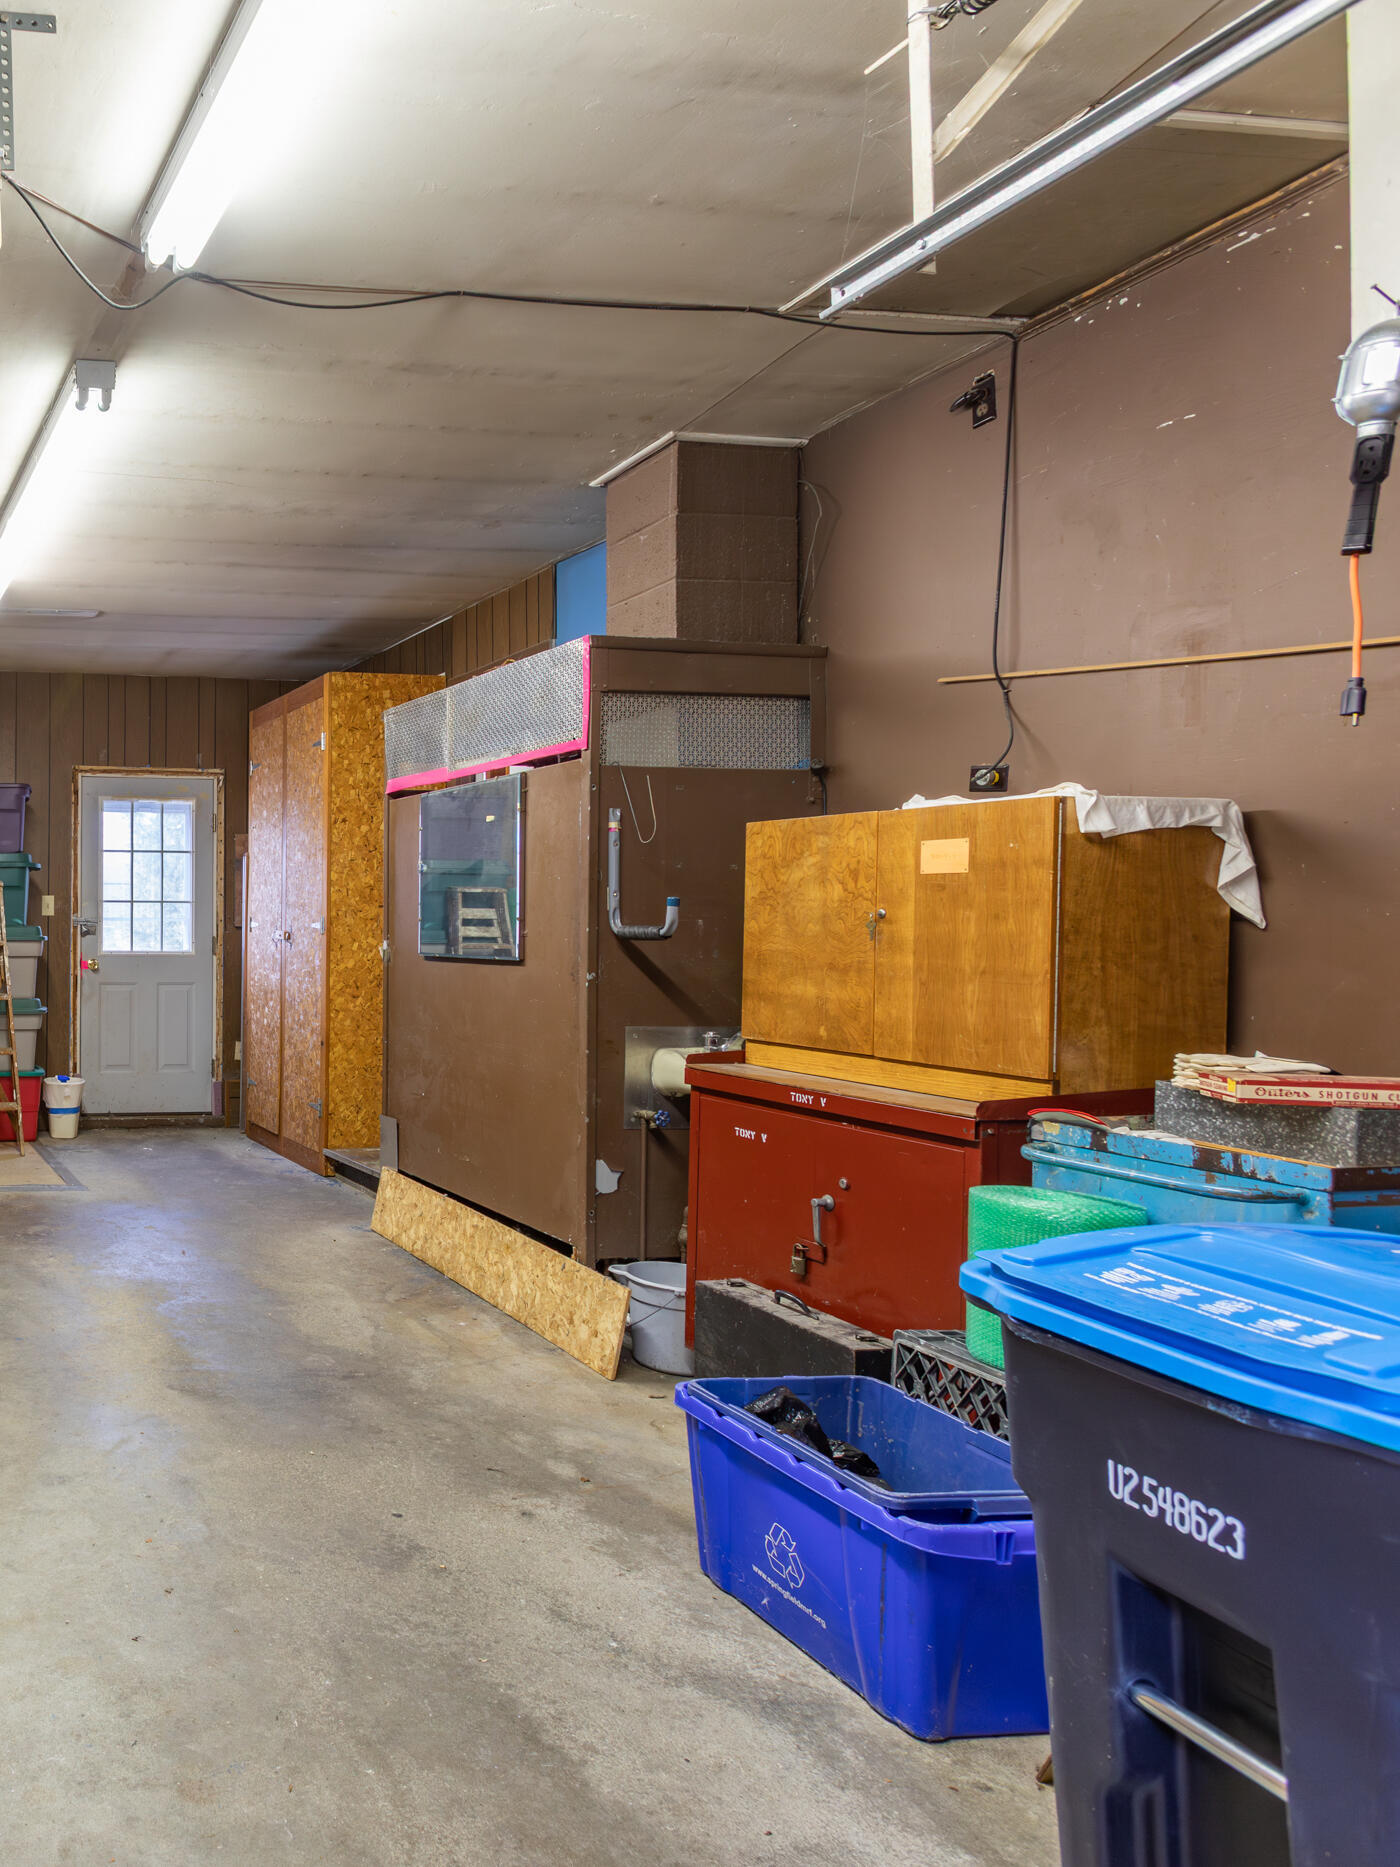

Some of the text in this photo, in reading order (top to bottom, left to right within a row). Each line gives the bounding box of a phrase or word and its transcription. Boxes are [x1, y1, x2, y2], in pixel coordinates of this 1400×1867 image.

[1255, 1086, 1311, 1100] Outers
[1319, 1090, 1379, 1101] SHOTGUN
[820, 1096, 827, 1107] V
[761, 1133, 768, 1143] V
